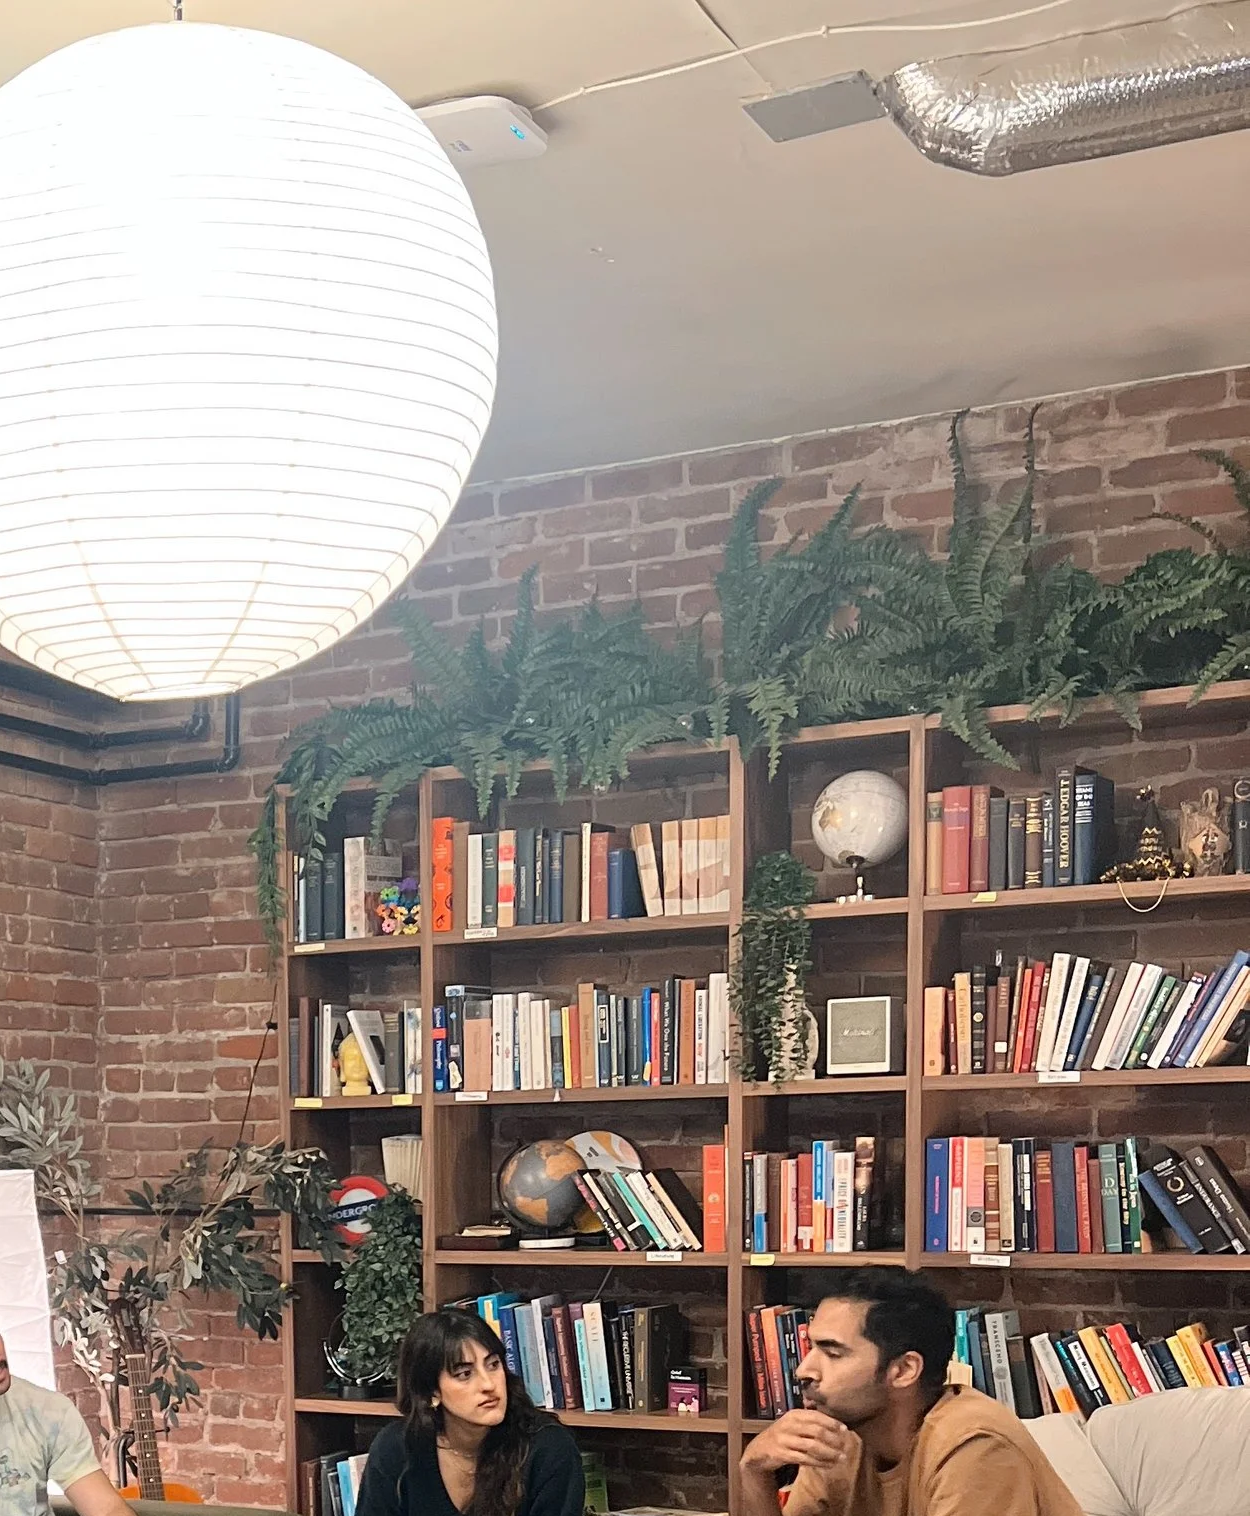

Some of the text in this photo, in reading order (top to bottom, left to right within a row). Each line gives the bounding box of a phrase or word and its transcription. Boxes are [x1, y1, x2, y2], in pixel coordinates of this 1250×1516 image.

[1060, 787, 1069, 823] EDGAR
[1060, 825, 1069, 868] HOOVER
[1105, 1177, 1115, 1188] D
[1195, 1183, 1222, 1219] ENDURANCE
[748, 1312, 759, 1333] Super
[503, 1329, 513, 1350] BASIC
[750, 1333, 761, 1362] Pumped
[992, 1320, 1003, 1364] TRANSCEND
